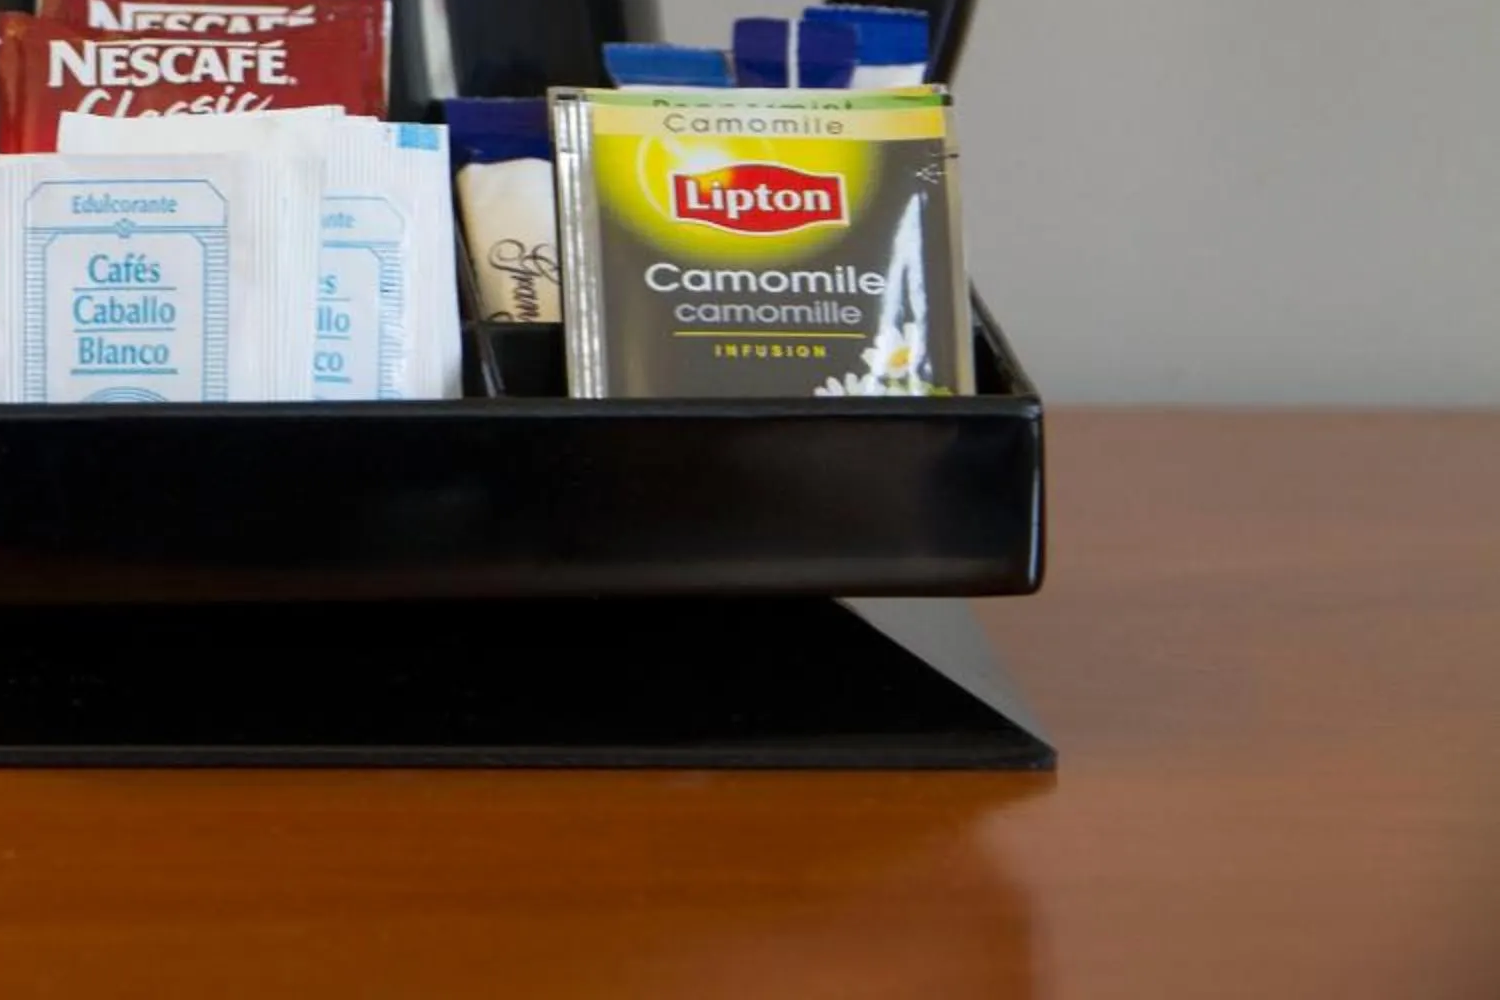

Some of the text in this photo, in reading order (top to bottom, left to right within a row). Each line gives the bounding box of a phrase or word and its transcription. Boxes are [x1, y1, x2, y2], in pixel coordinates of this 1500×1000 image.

[48, 39, 289, 87] NESCAFÉ
[662, 113, 845, 135] Camomile
[71, 195, 177, 214] Edulcorante
[685, 179, 832, 219] Lipton
[87, 252, 161, 284] Cafés
[644, 262, 886, 295] Camomile
[72, 295, 176, 325] Caballo
[674, 299, 863, 326] camomille
[77, 336, 170, 365] Blanco
[714, 343, 828, 358] INFUSION
